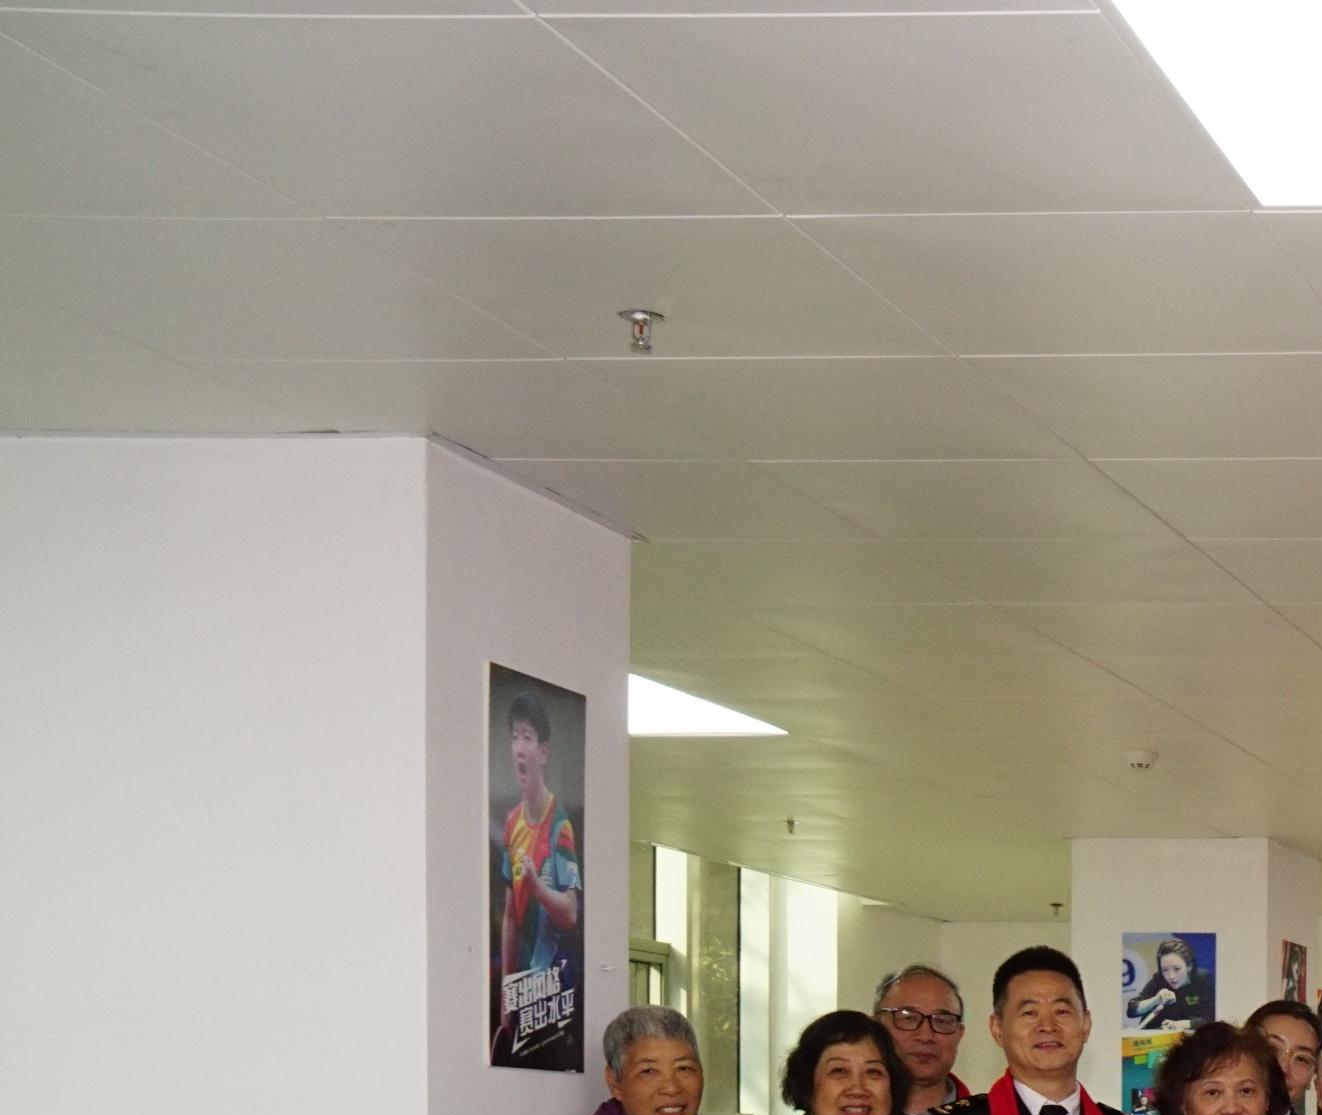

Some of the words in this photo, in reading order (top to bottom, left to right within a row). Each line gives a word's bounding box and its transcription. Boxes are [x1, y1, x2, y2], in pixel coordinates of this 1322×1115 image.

[503, 966, 560, 1015] 赛出风格
[520, 989, 576, 1037] 赛出水平
